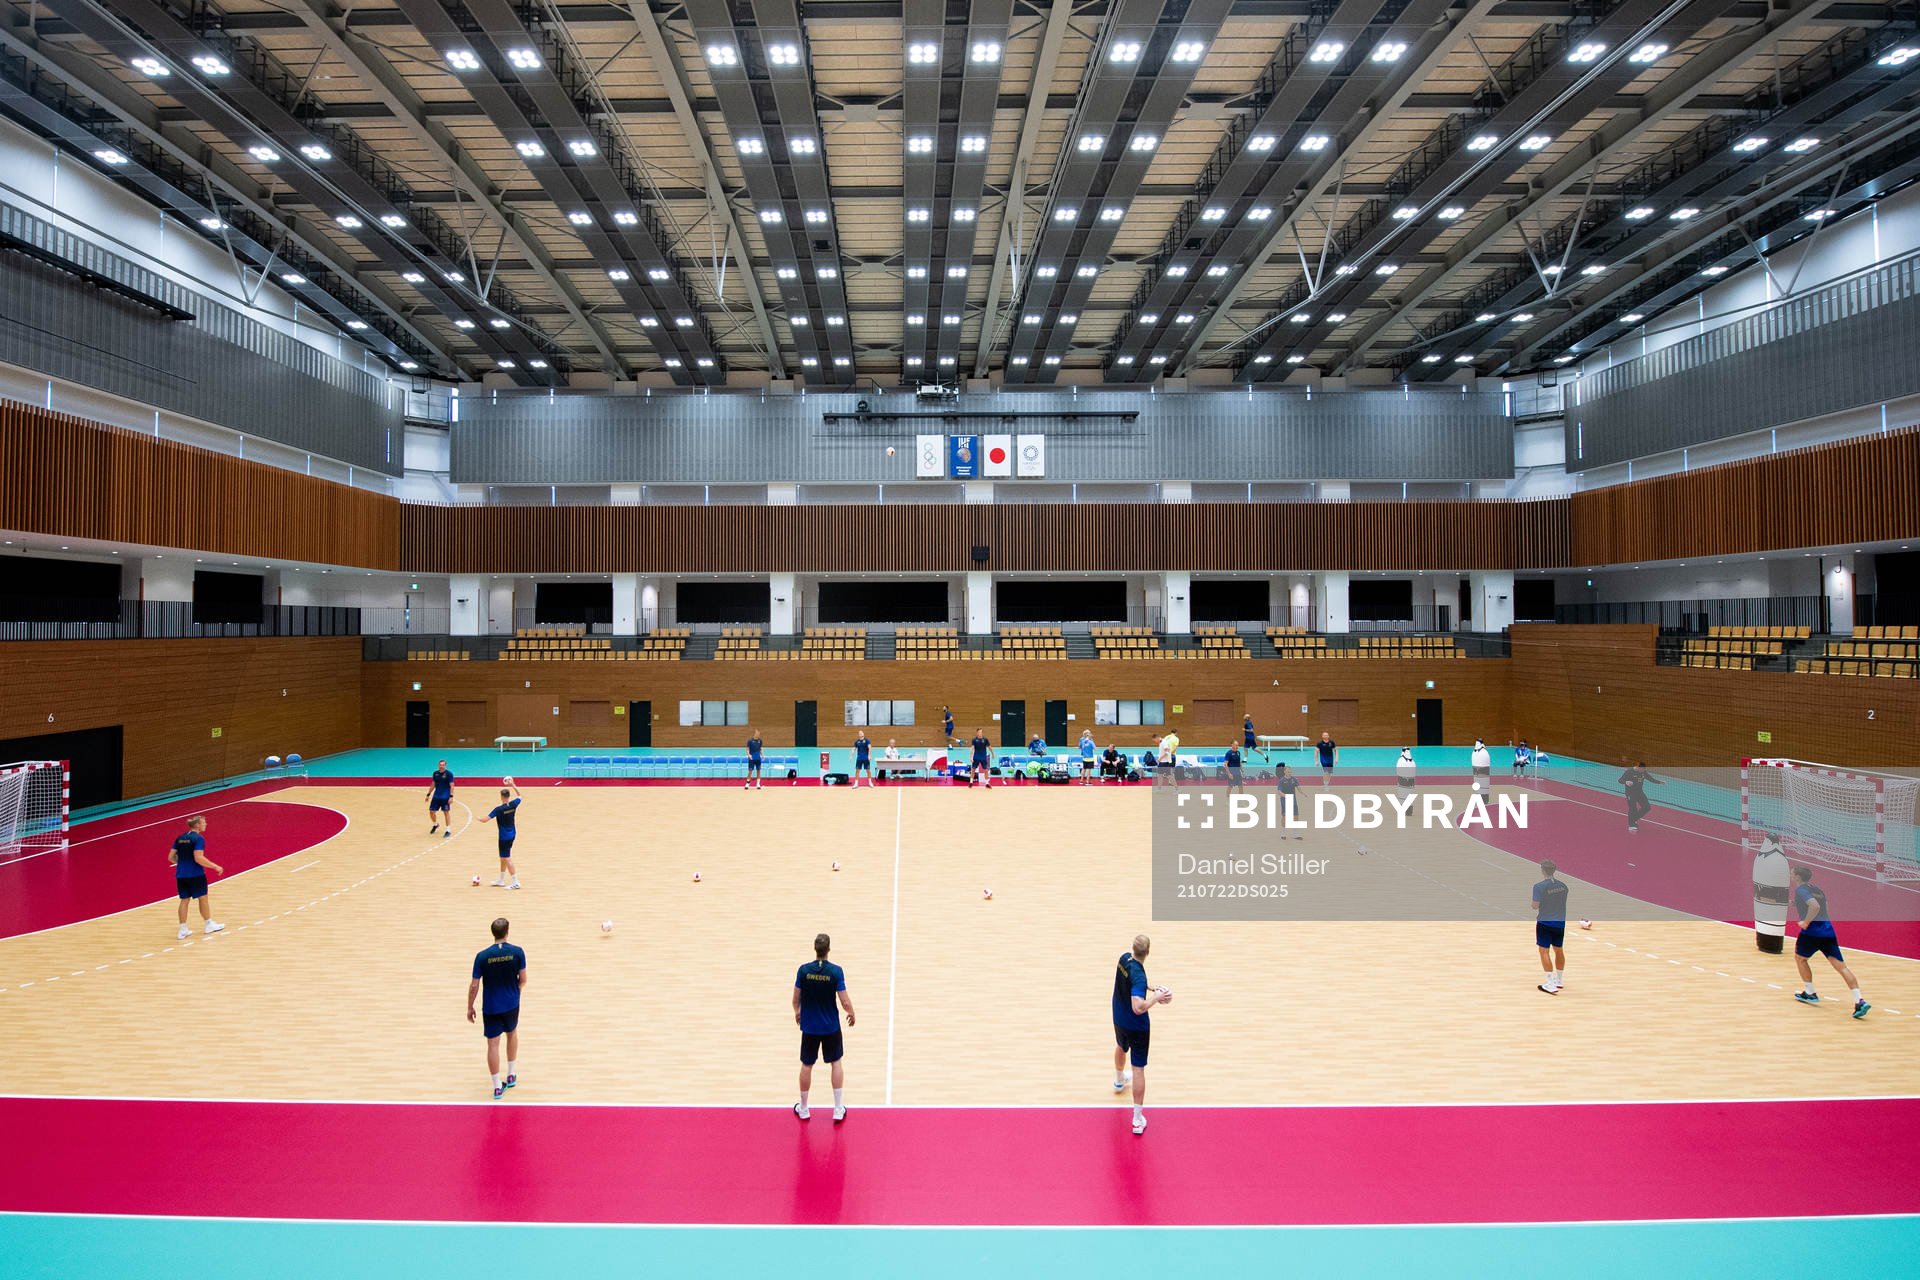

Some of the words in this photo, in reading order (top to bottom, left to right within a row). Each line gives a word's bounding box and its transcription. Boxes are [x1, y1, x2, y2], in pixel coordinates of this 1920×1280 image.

[282, 689, 287, 697] 5
[48, 713, 54, 722] 6
[1868, 710, 1875, 719] 2
[488, 955, 514, 964] SWEDEN
[806, 973, 831, 982] SWEDEN
